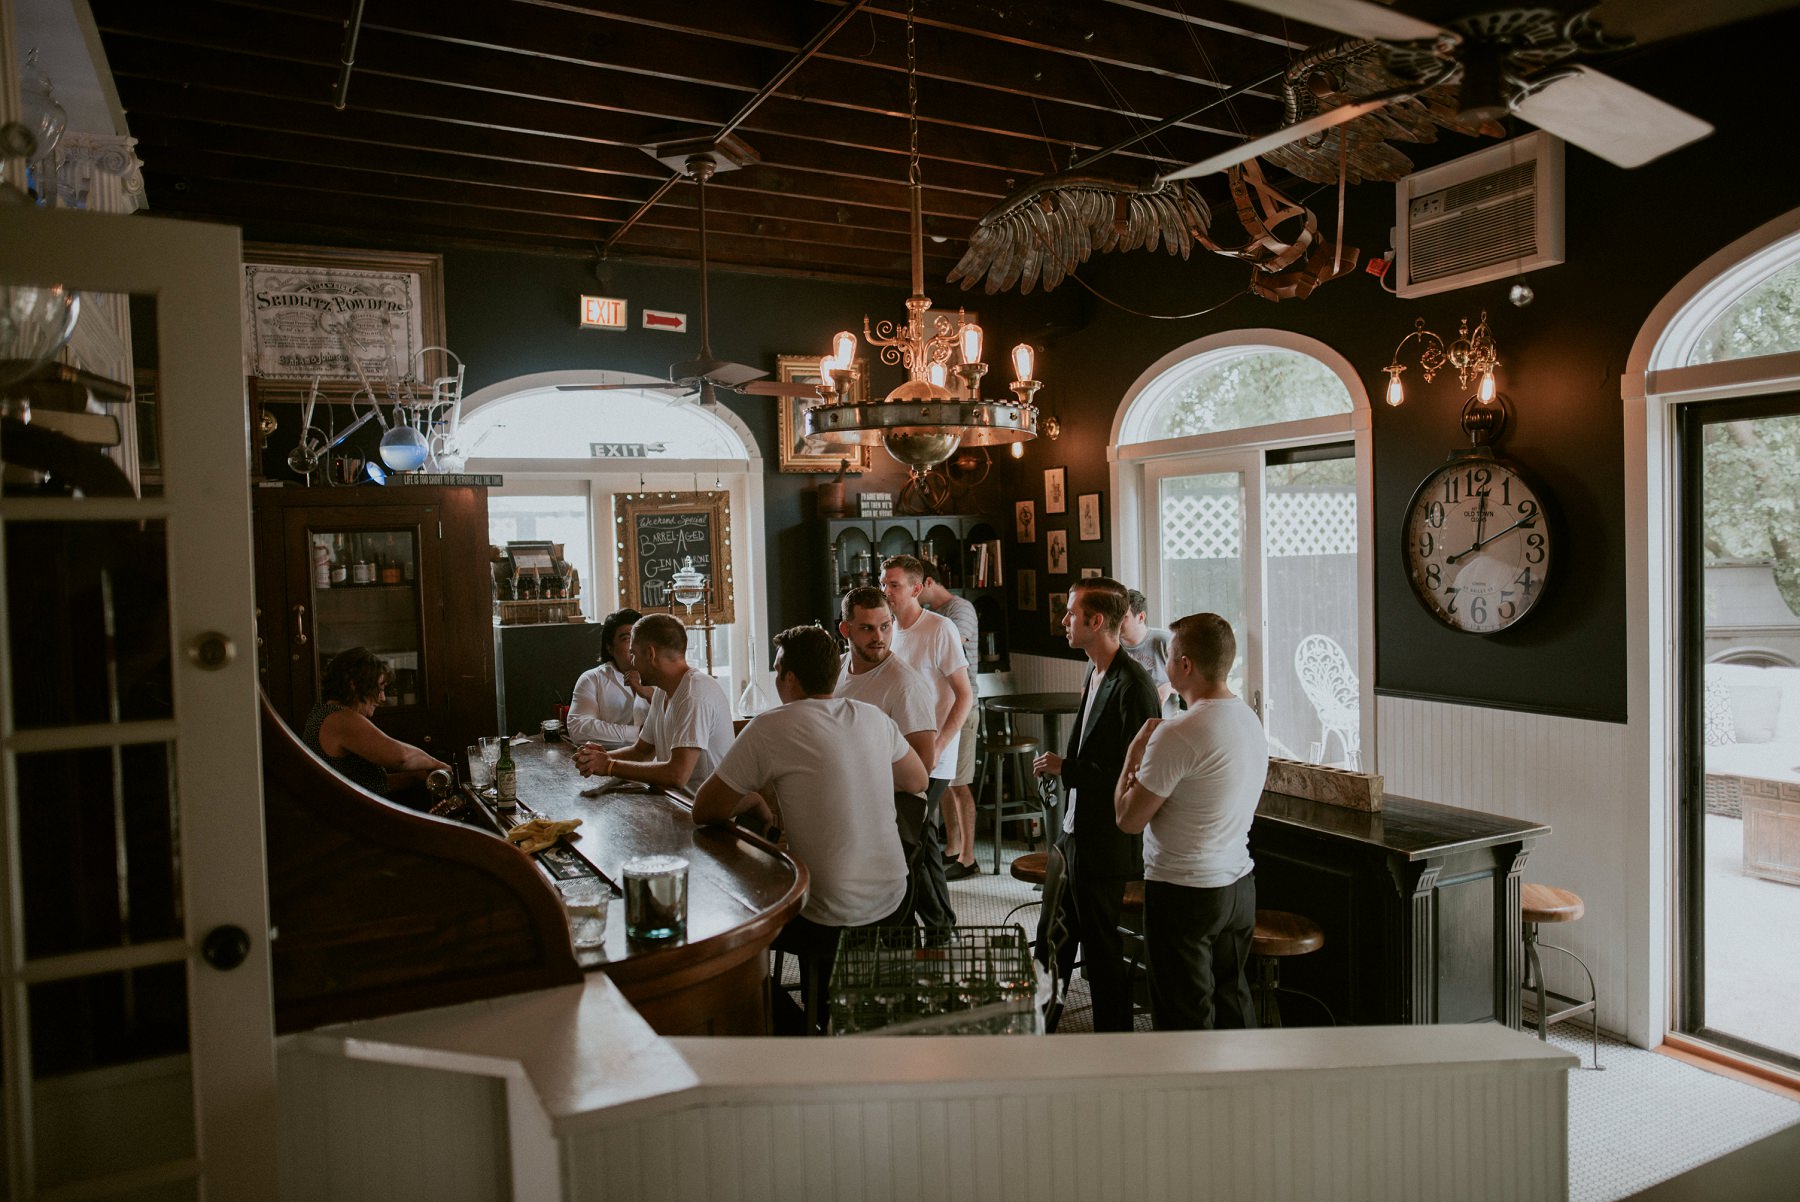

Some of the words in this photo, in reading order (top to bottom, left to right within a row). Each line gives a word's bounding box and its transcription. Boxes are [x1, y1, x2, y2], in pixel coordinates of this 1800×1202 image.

[586, 299, 620, 325] EXIT
[594, 444, 640, 457] EXIT
[404, 475, 413, 485] LIFE
[1443, 476, 1461, 504] 11
[1465, 468, 1492, 497] 12
[1501, 477, 1511, 506] 1
[639, 516, 676, 528] Weekend
[677, 514, 708, 525] Special
[1423, 501, 1444, 529] 10
[1517, 500, 1537, 529] 2
[1419, 532, 1434, 558] 9
[1525, 533, 1545, 564] 3
[673, 555, 709, 574] NRONI
[1425, 563, 1441, 591] 8
[1513, 566, 1533, 596] 4
[1444, 587, 1462, 615] 7
[1470, 596, 1487, 624] 6
[1498, 591, 1516, 619] 5
